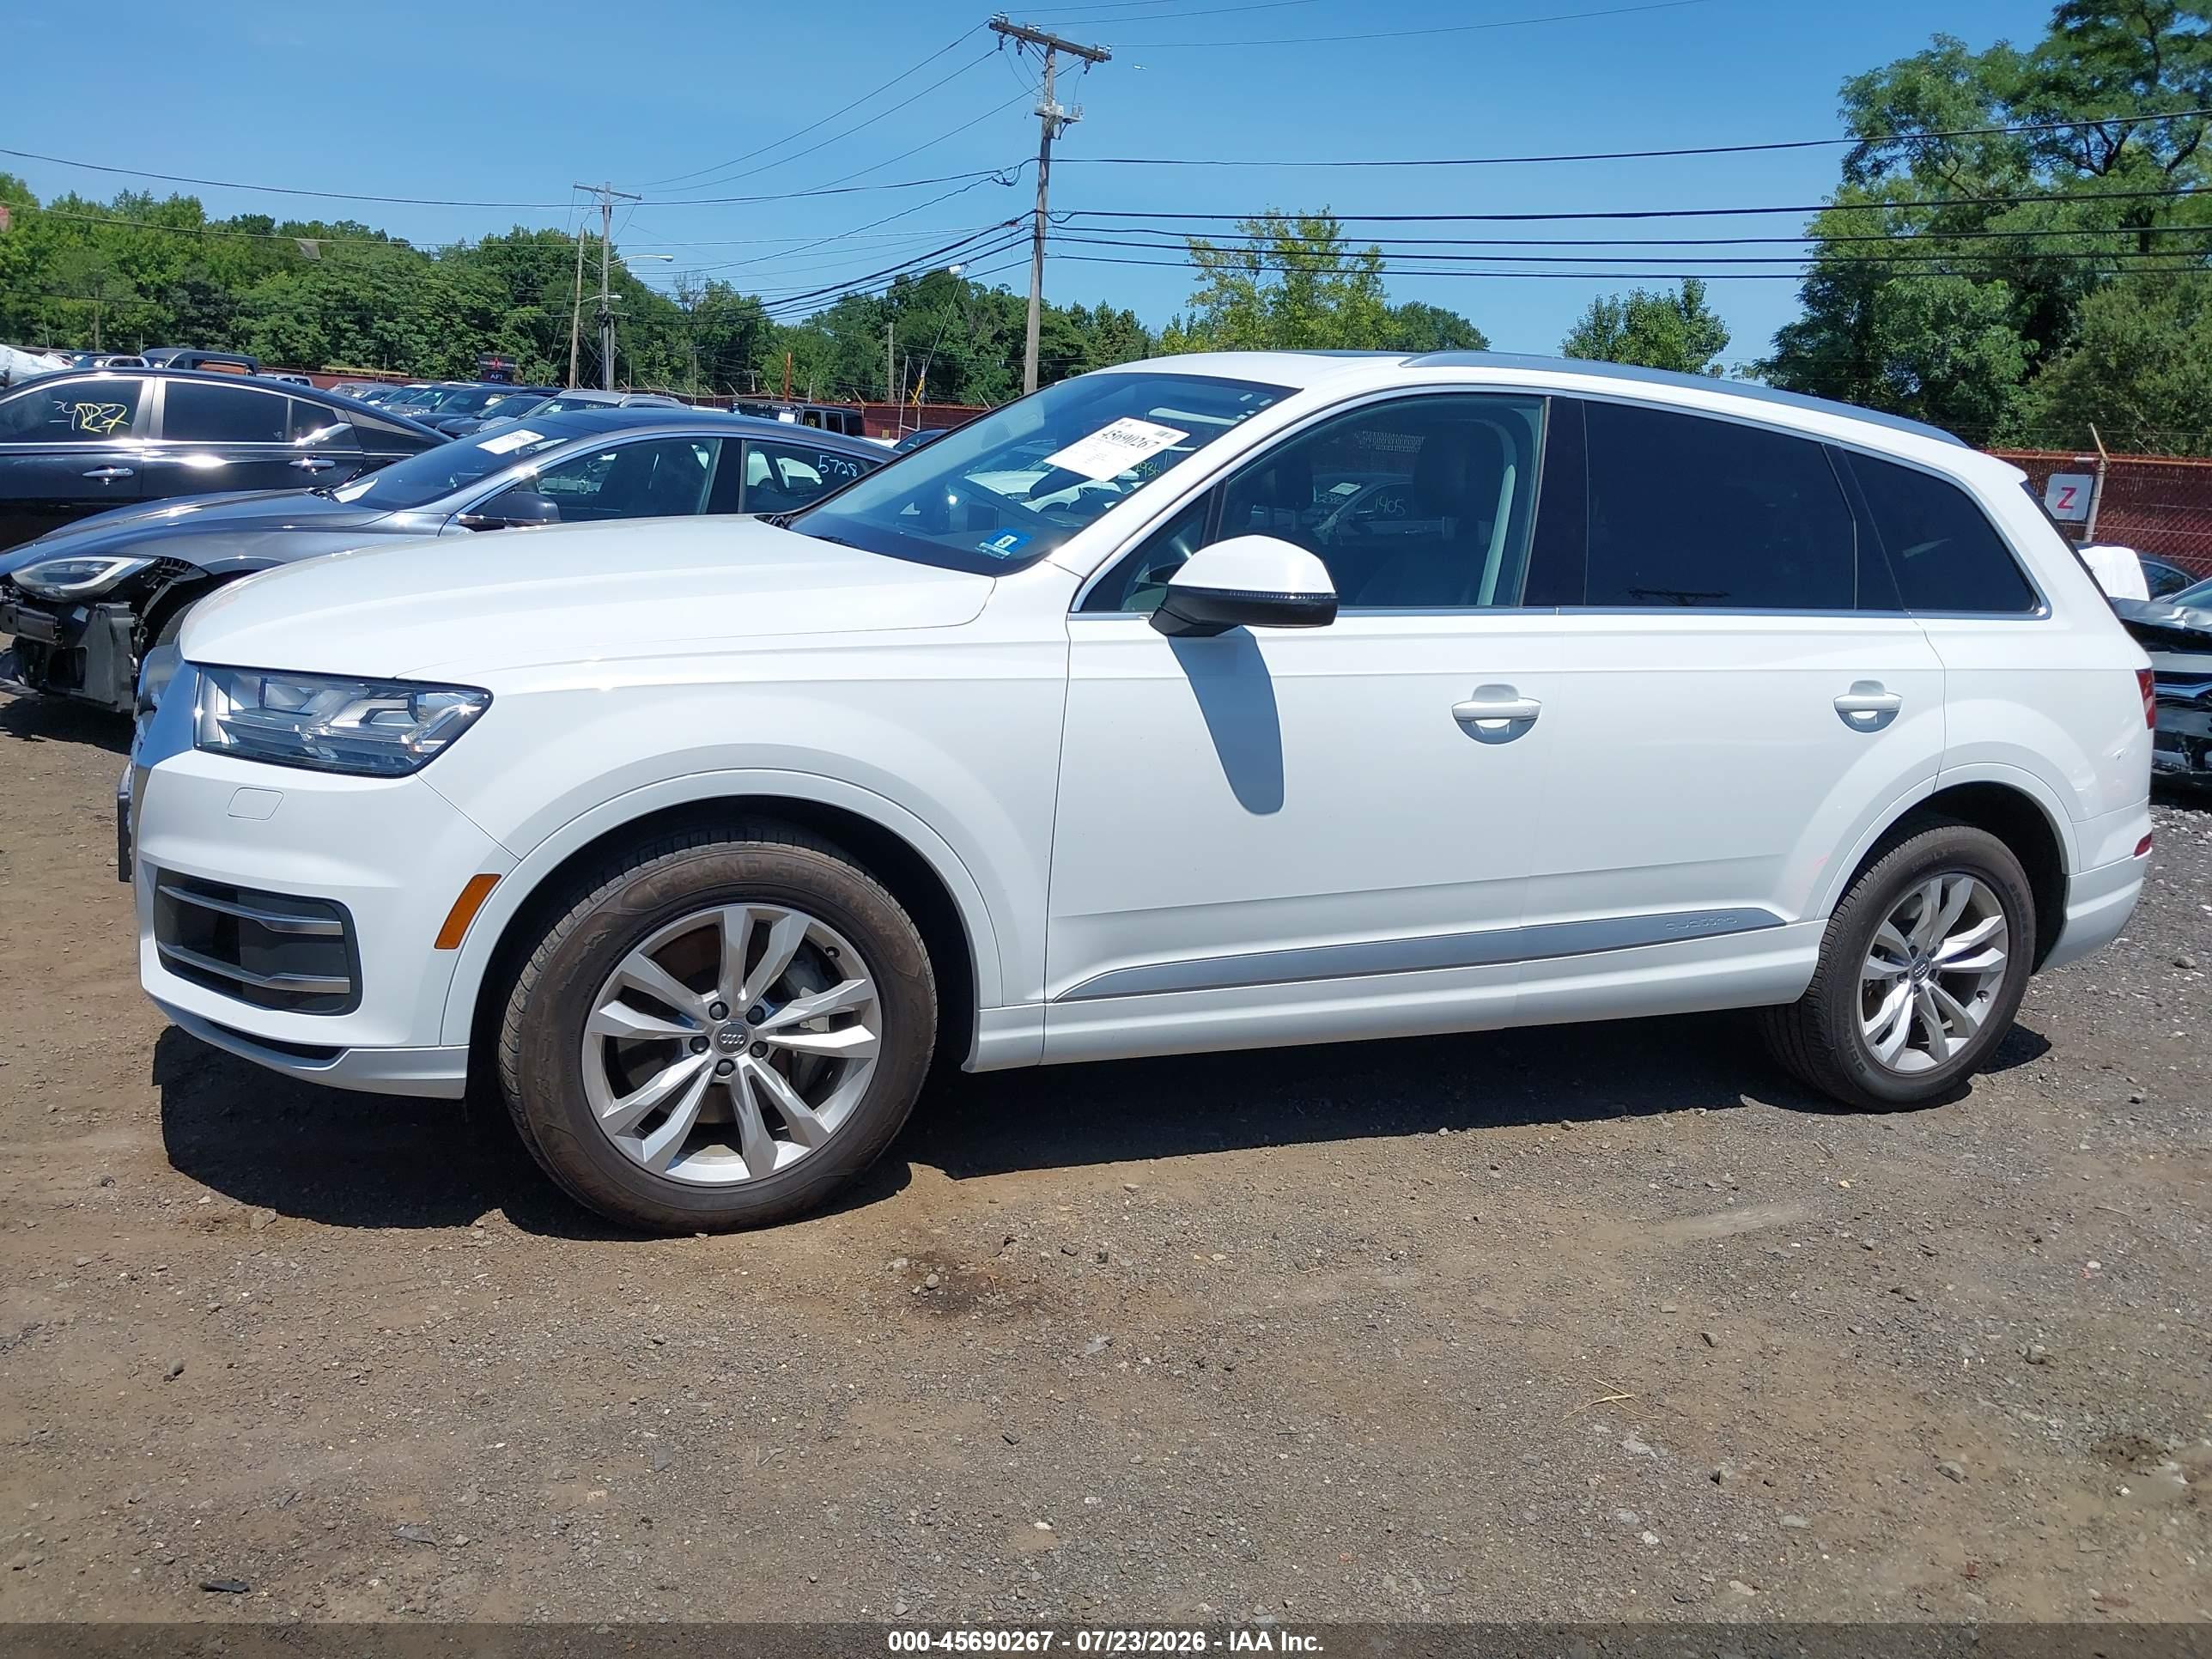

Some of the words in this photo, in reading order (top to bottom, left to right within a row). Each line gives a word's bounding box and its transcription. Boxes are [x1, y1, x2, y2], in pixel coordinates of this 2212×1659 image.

[817, 454, 859, 477] 5728
[1374, 495, 1415, 517] 1405
[2056, 486, 2078, 509] Z
